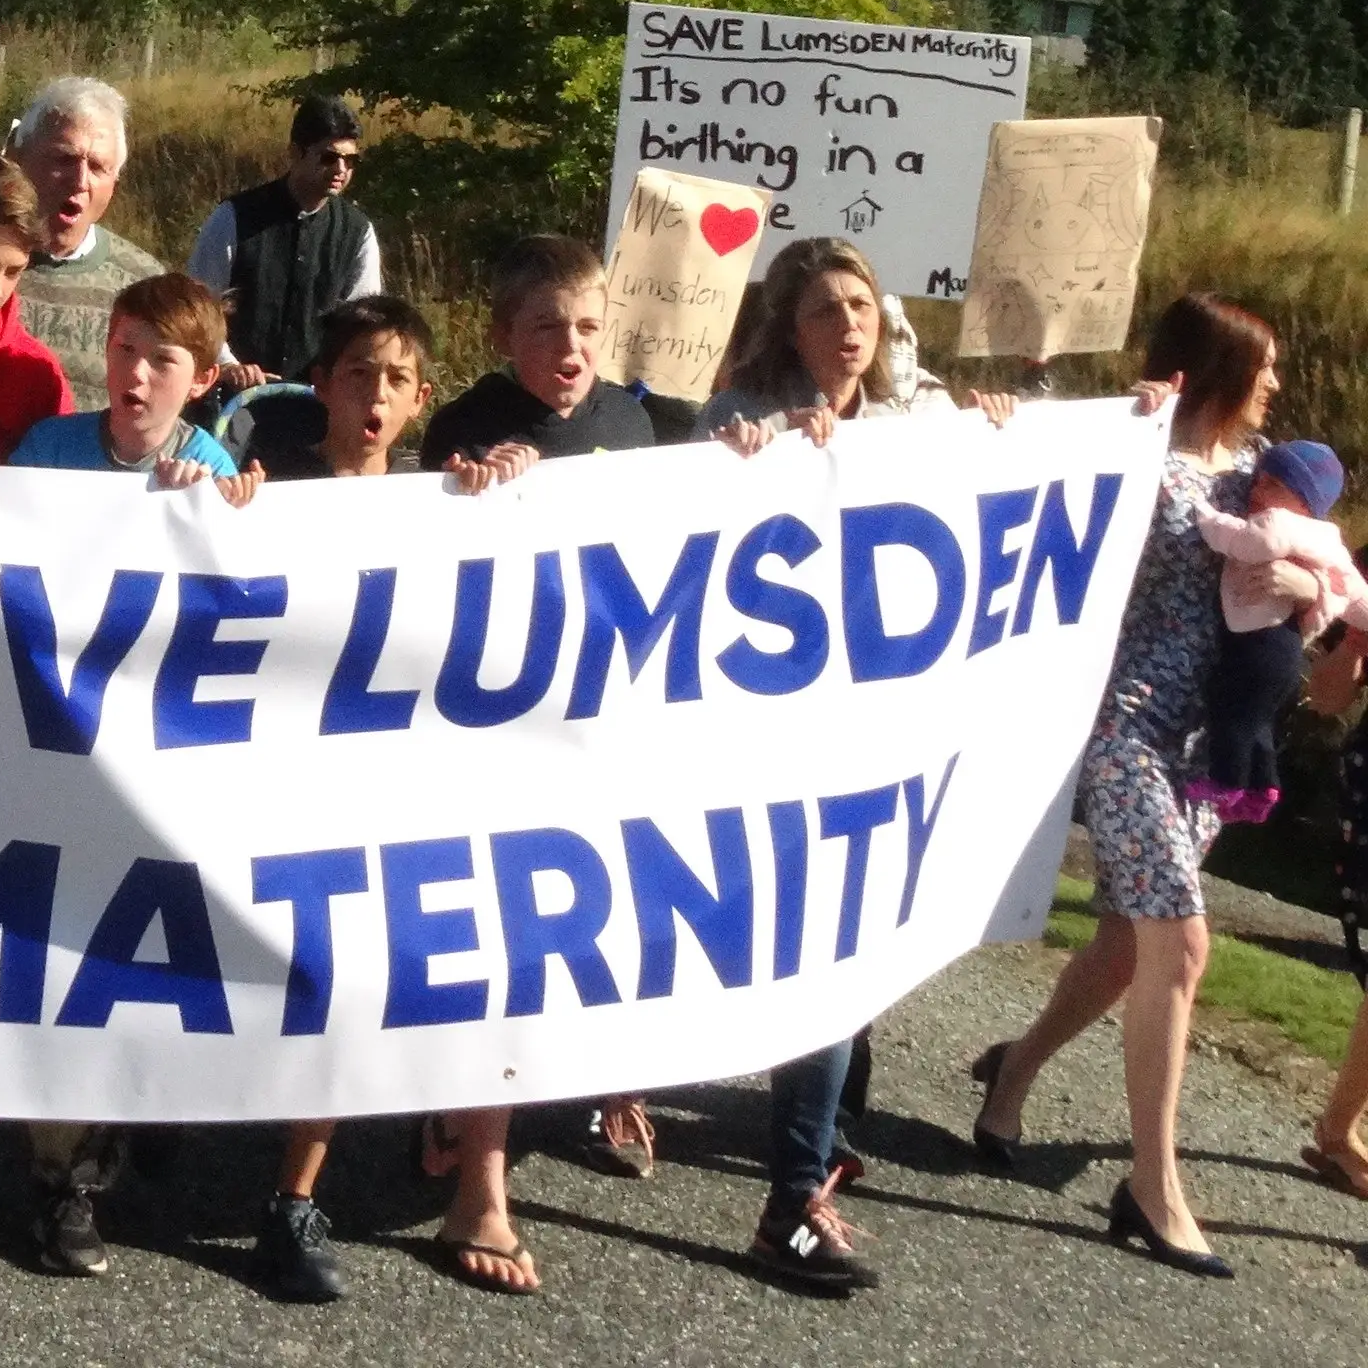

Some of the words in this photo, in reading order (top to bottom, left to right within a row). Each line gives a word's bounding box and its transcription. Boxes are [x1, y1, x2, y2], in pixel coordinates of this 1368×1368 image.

[643, 11, 744, 52] SAVE
[911, 34, 1018, 78] Maternity
[630, 65, 702, 105] Its
[721, 78, 787, 107] no
[814, 73, 899, 118] fun
[639, 118, 799, 192] birthing
[827, 136, 877, 175] in
[895, 150, 925, 175] a
[633, 184, 684, 237] We
[320, 472, 1123, 737] LUMSDEN
